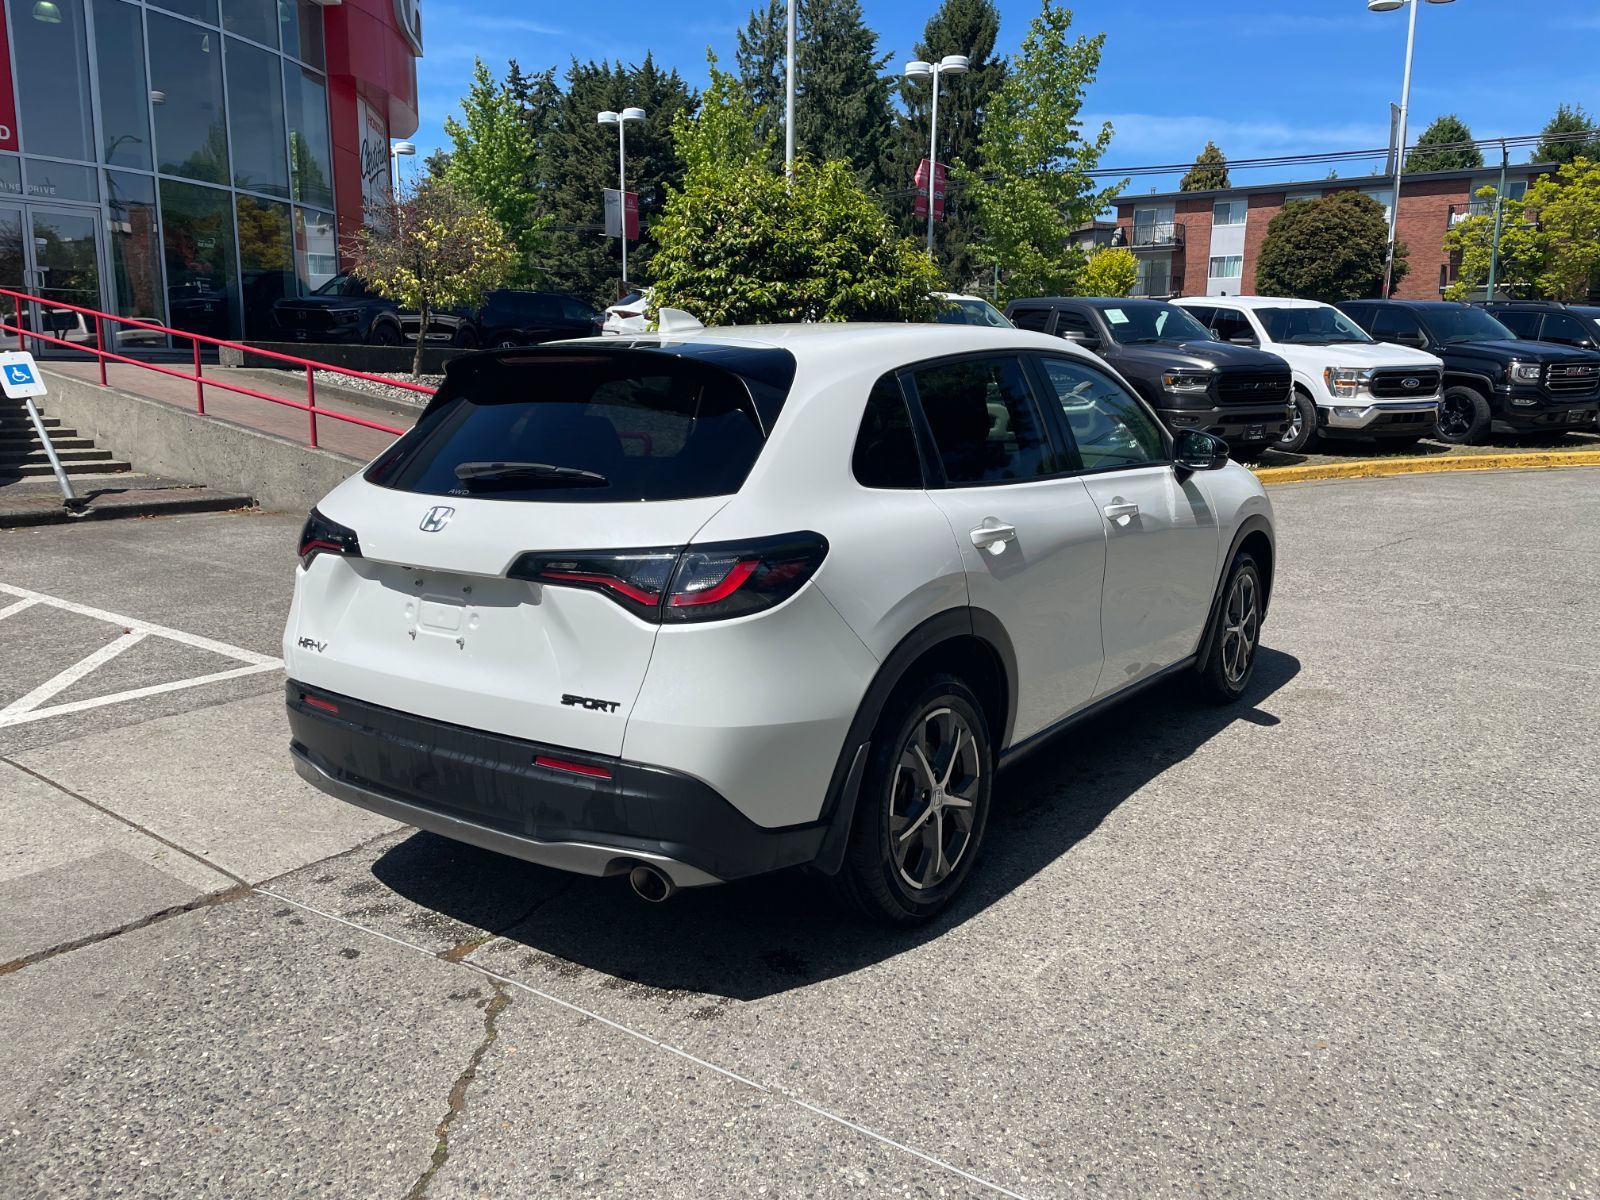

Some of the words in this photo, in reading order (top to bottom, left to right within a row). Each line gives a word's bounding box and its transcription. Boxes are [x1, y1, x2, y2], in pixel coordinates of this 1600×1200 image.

[27, 184, 56, 195] DRIVE
[298, 636, 328, 653] HR-V
[560, 693, 621, 714] SPORT
